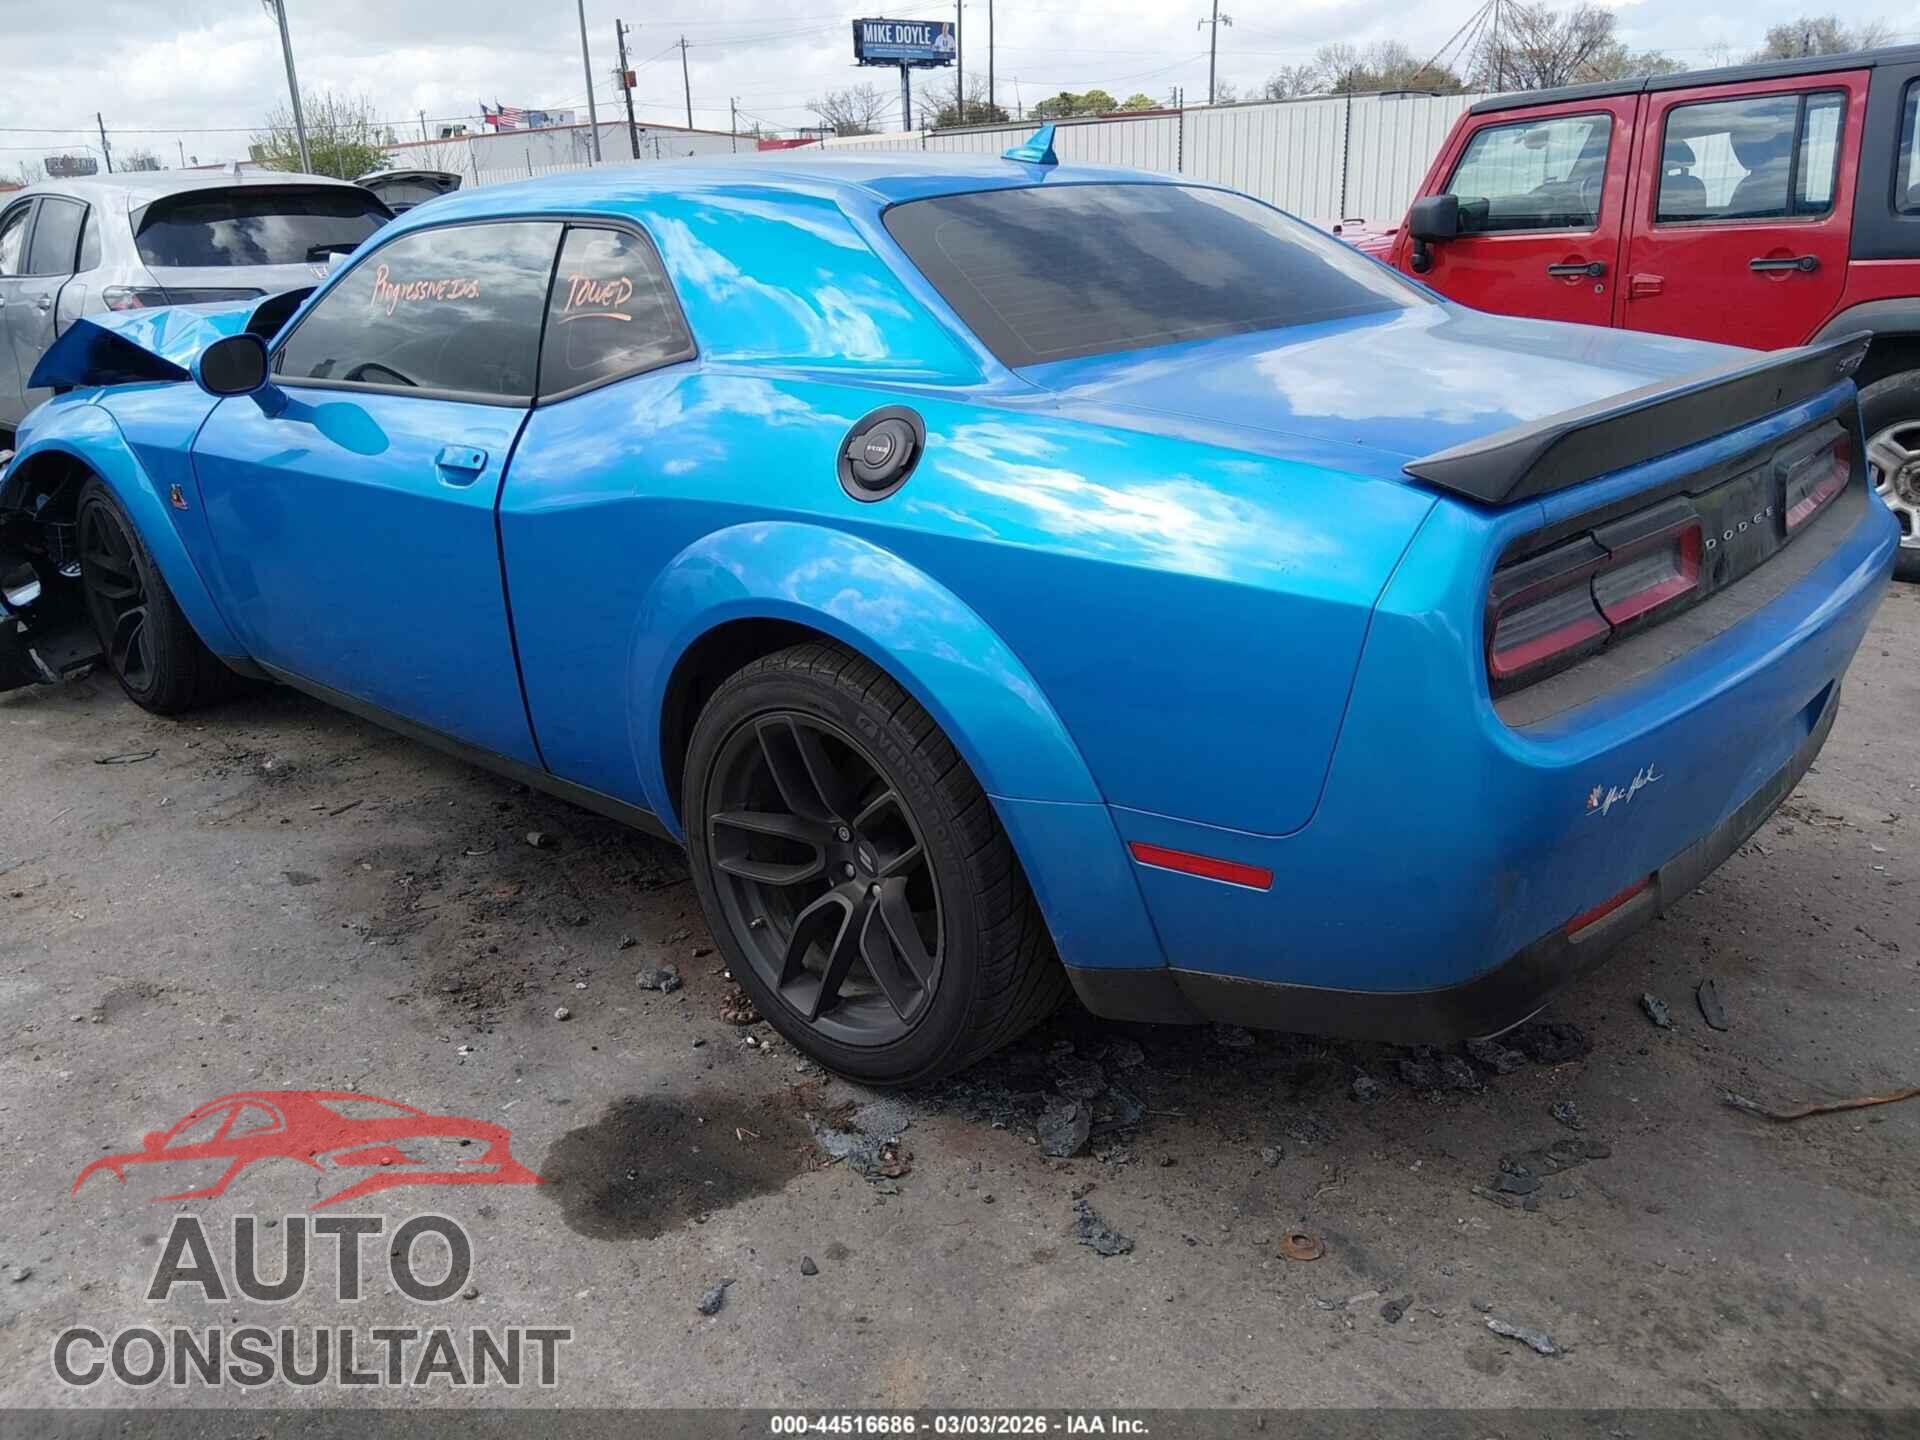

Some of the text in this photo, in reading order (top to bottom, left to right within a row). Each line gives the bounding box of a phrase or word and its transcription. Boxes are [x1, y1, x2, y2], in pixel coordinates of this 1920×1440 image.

[863, 24, 931, 45] MIKE DOYLE
[1705, 505, 1774, 551] DODGE
